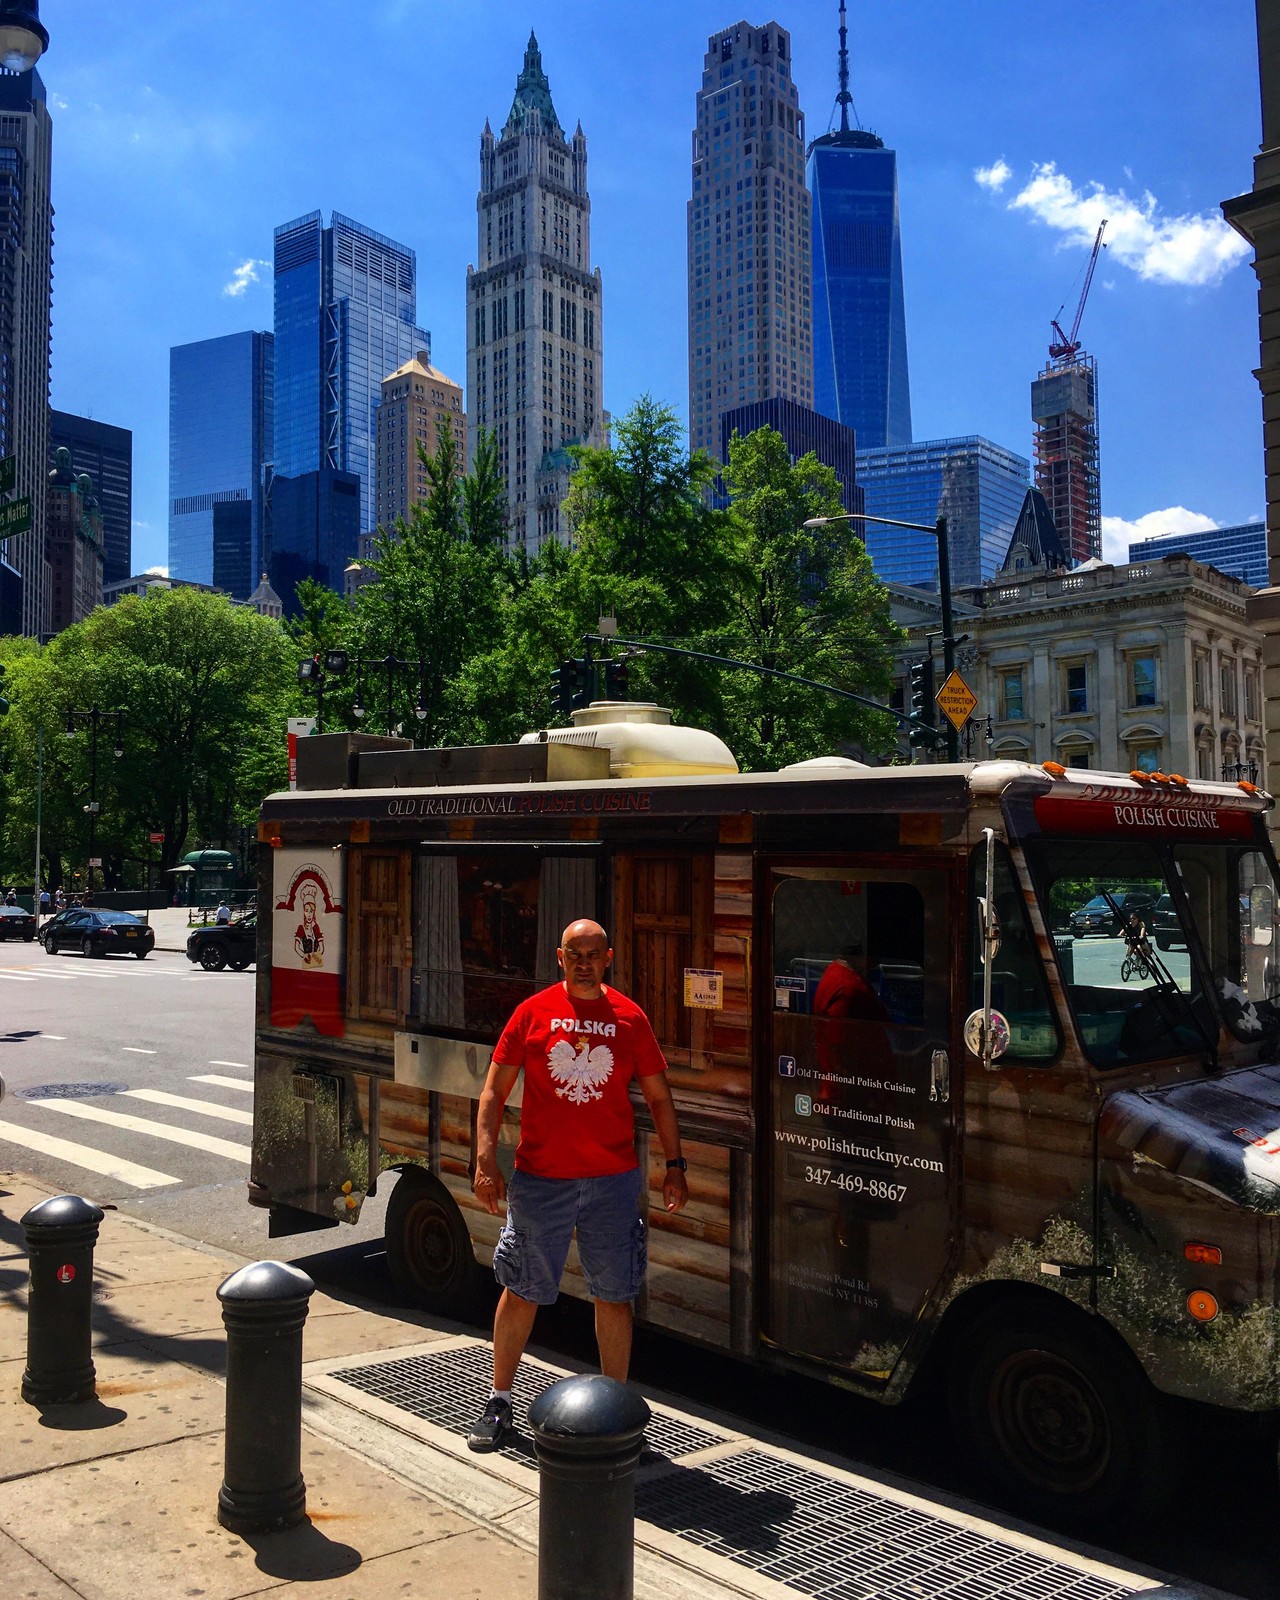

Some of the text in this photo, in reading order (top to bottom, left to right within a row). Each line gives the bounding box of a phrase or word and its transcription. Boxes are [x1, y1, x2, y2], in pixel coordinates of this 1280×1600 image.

[7, 503, 29, 524] Matter
[940, 696, 974, 705] RESTRICTION
[947, 687, 966, 695] TRUCK
[948, 707, 968, 715] AHEAD
[387, 791, 651, 816] OLD TRADITIONAL POLISH CUISINE
[1113, 806, 1220, 829] POLISH CUISINE
[550, 1018, 616, 1037] POLSKA
[797, 1068, 812, 1078] Old
[813, 1070, 855, 1085] Traditional
[857, 1078, 882, 1089] Polish
[884, 1081, 916, 1095] Cuisine
[813, 1103, 830, 1115] Old
[832, 1106, 882, 1124] Traditional
[885, 1115, 915, 1130] Polish
[774, 1130, 945, 1173] www.polishtrucknyc.com
[804, 1166, 907, 1202] 347-469-8867
[834, 1274, 856, 1288] Pond
[836, 1288, 850, 1301] NY
